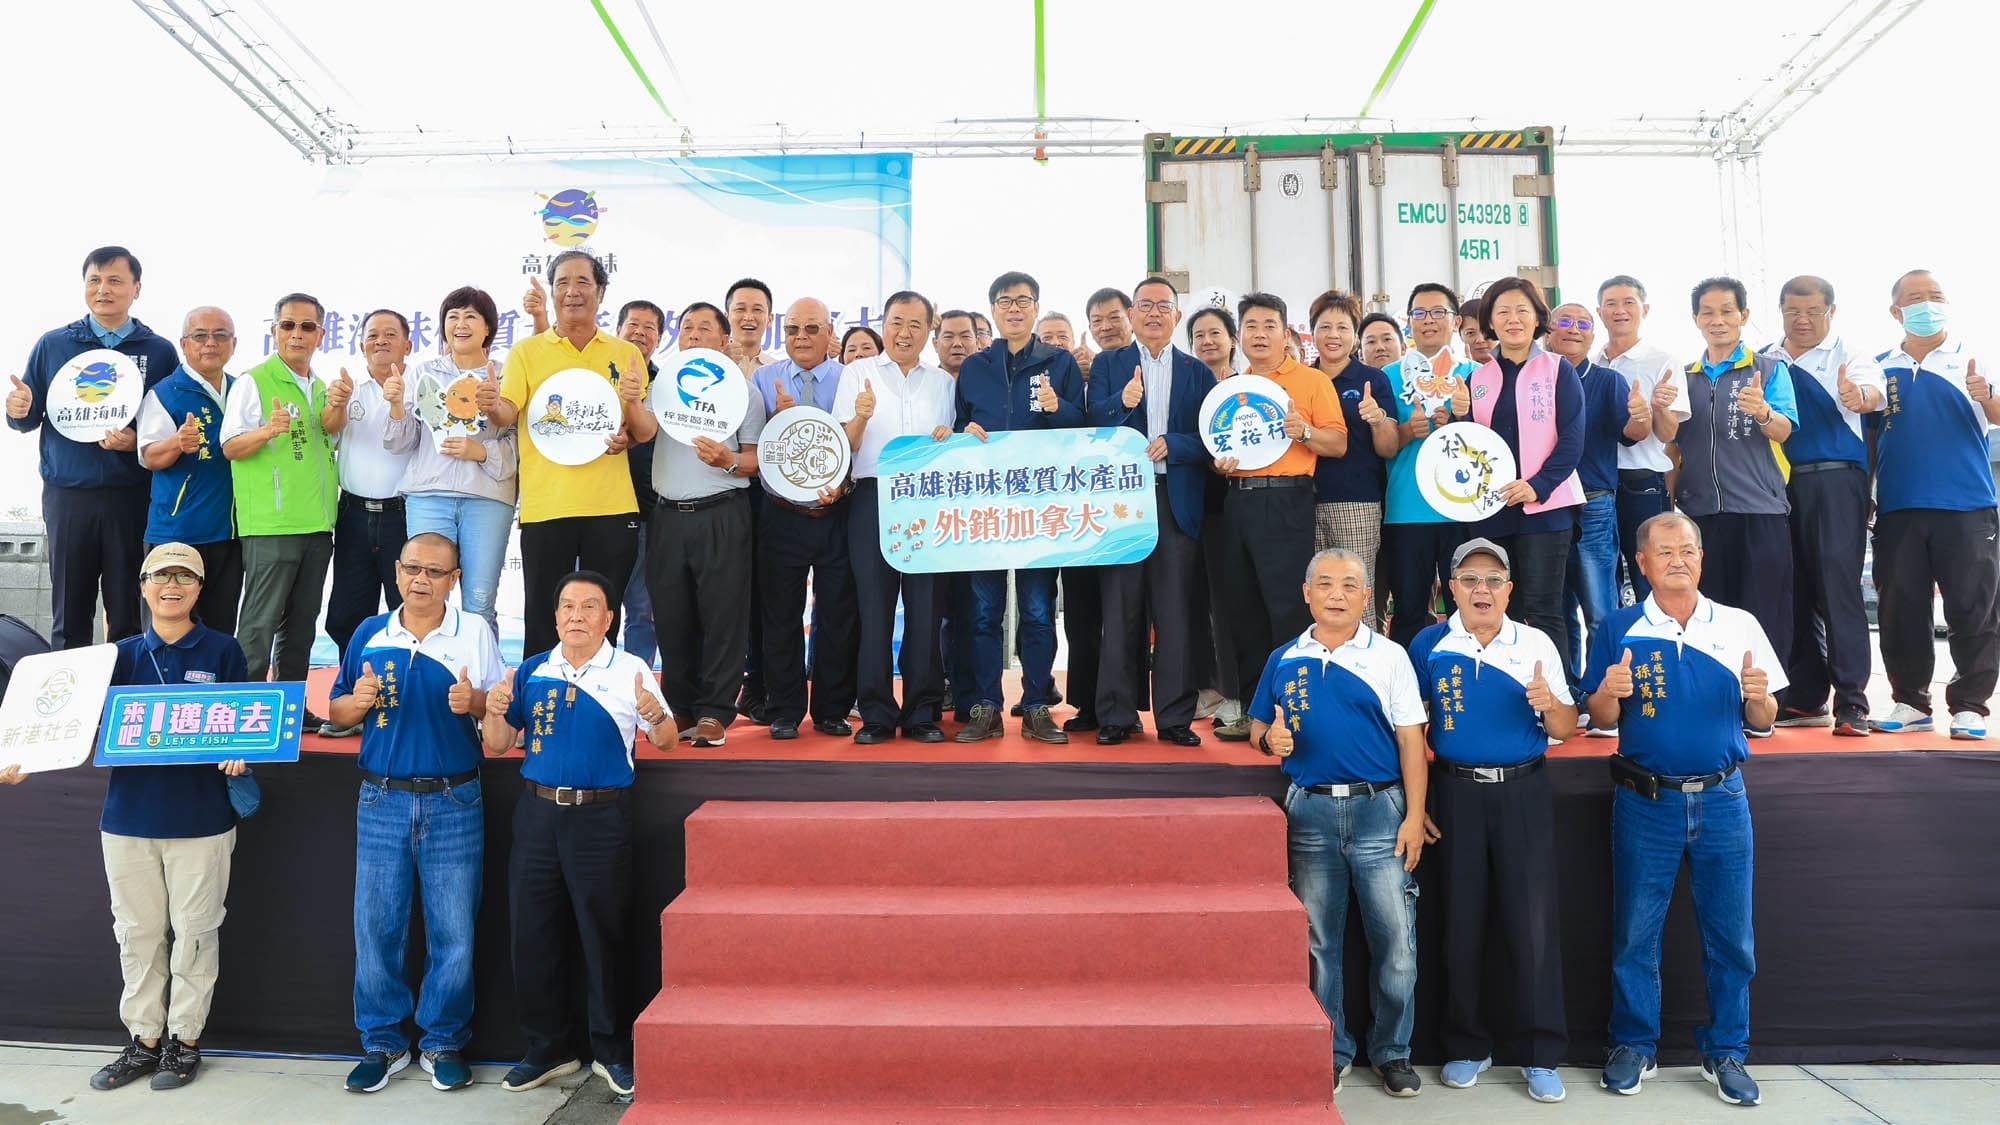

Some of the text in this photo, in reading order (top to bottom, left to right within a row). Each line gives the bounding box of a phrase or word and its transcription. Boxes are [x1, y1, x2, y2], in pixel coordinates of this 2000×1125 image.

[1398, 203, 1527, 225] EMCU 543928 8
[1459, 239, 1499, 260] 45R1
[57, 404, 128, 422] 高雄海味
[566, 400, 608, 420] 蘇班長
[694, 400, 716, 414] TFA
[1235, 412, 1257, 422] HONG
[1242, 420, 1253, 428] YU
[1213, 421, 1286, 453] 宏裕行
[889, 463, 1144, 501] 高雄海味優質水產品
[933, 503, 1106, 545] 外銷加拿大
[1634, 663, 1656, 719] 孫萬賜
[165, 735, 229, 746] LET'S FISH
